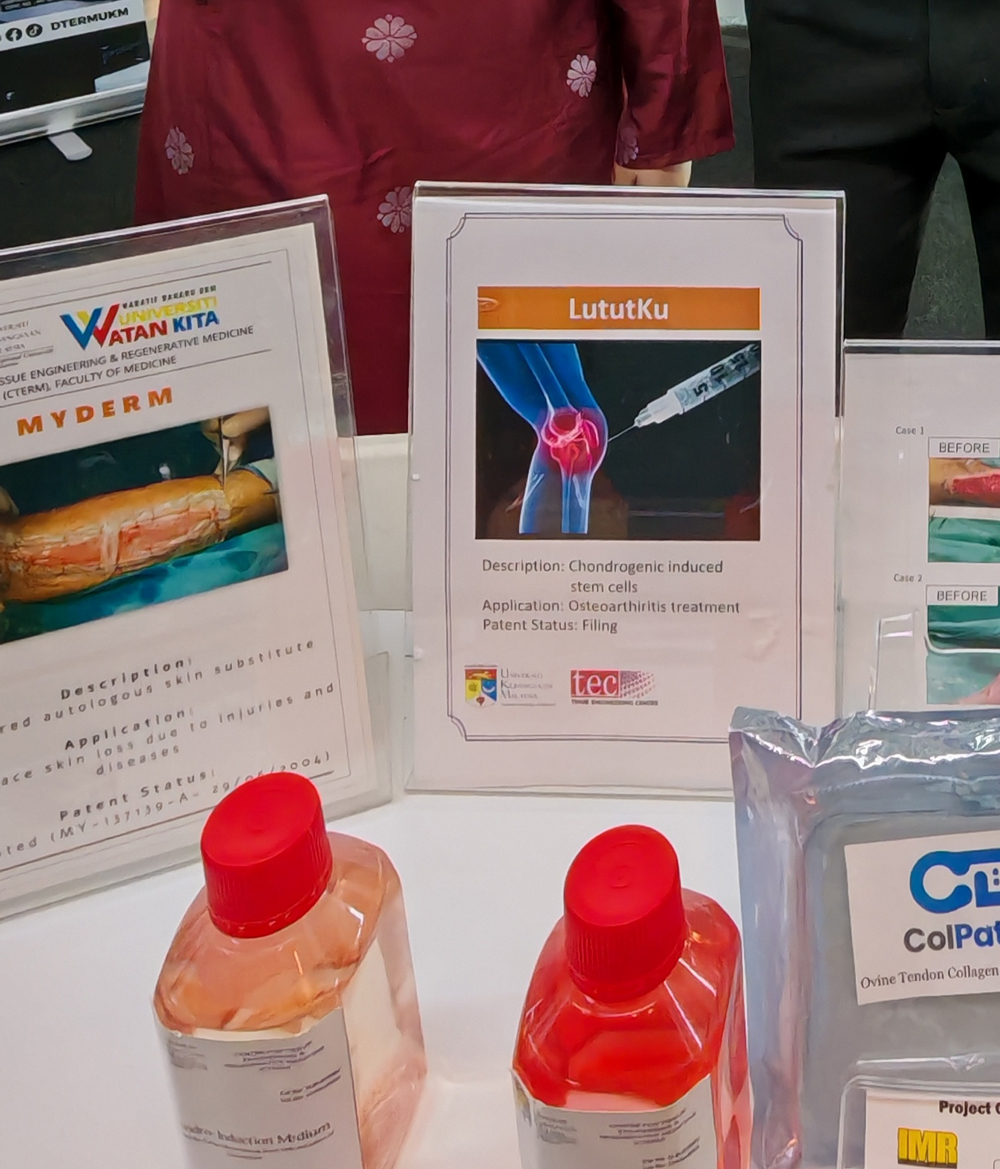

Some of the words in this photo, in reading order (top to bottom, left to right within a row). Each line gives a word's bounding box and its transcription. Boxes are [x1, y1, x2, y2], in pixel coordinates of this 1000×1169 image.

[50, 7, 129, 31] DTERMUKM
[118, 295, 218, 326] UNIVERSITI
[569, 297, 669, 320] LututKu
[172, 310, 220, 334] KITA
[30, 356, 107, 380] ENGINEERING
[109, 353, 119, 363] &
[121, 337, 199, 360] REGENERATIVE
[202, 325, 254, 344] MEDICINE
[55, 370, 103, 389] FACULTY
[106, 367, 121, 378] OF
[124, 355, 177, 374] MEDICINE
[17, 386, 174, 436] MYDERM
[896, 426, 916, 436] Case
[938, 441, 990, 454] BEFORE
[482, 558, 565, 575] Description:
[568, 559, 665, 575] Chondrogenic
[668, 559, 723, 574] induced
[893, 573, 914, 584] Case
[917, 573, 923, 583] 2
[571, 582, 604, 594] stem
[608, 580, 638, 593] cells
[936, 589, 988, 602] BEFORE
[482, 599, 564, 614] Application:
[671, 601, 740, 614] treatment
[482, 618, 527, 632] Patent
[531, 618, 578, 632] Status:
[582, 618, 618, 634] Filing
[43, 683, 153, 722] autologous
[165, 670, 203, 689] skin
[214, 639, 314, 676] substitute
[60, 657, 193, 700] Description:
[572, 670, 618, 697] tec
[45, 753, 85, 774] skin
[96, 740, 134, 759] loss
[146, 727, 178, 745] due
[303, 682, 335, 700] and
[64, 707, 194, 751] Application:
[96, 743, 180, 776] diseases
[59, 793, 129, 821] Patent
[860, 975, 896, 989] Ovine
[898, 968, 945, 984] Tendon
[947, 964, 1000, 981] Collagen
[939, 1100, 991, 1117] Project
[276, 1121, 331, 1146] Medium
[897, 1127, 958, 1169] IMR
